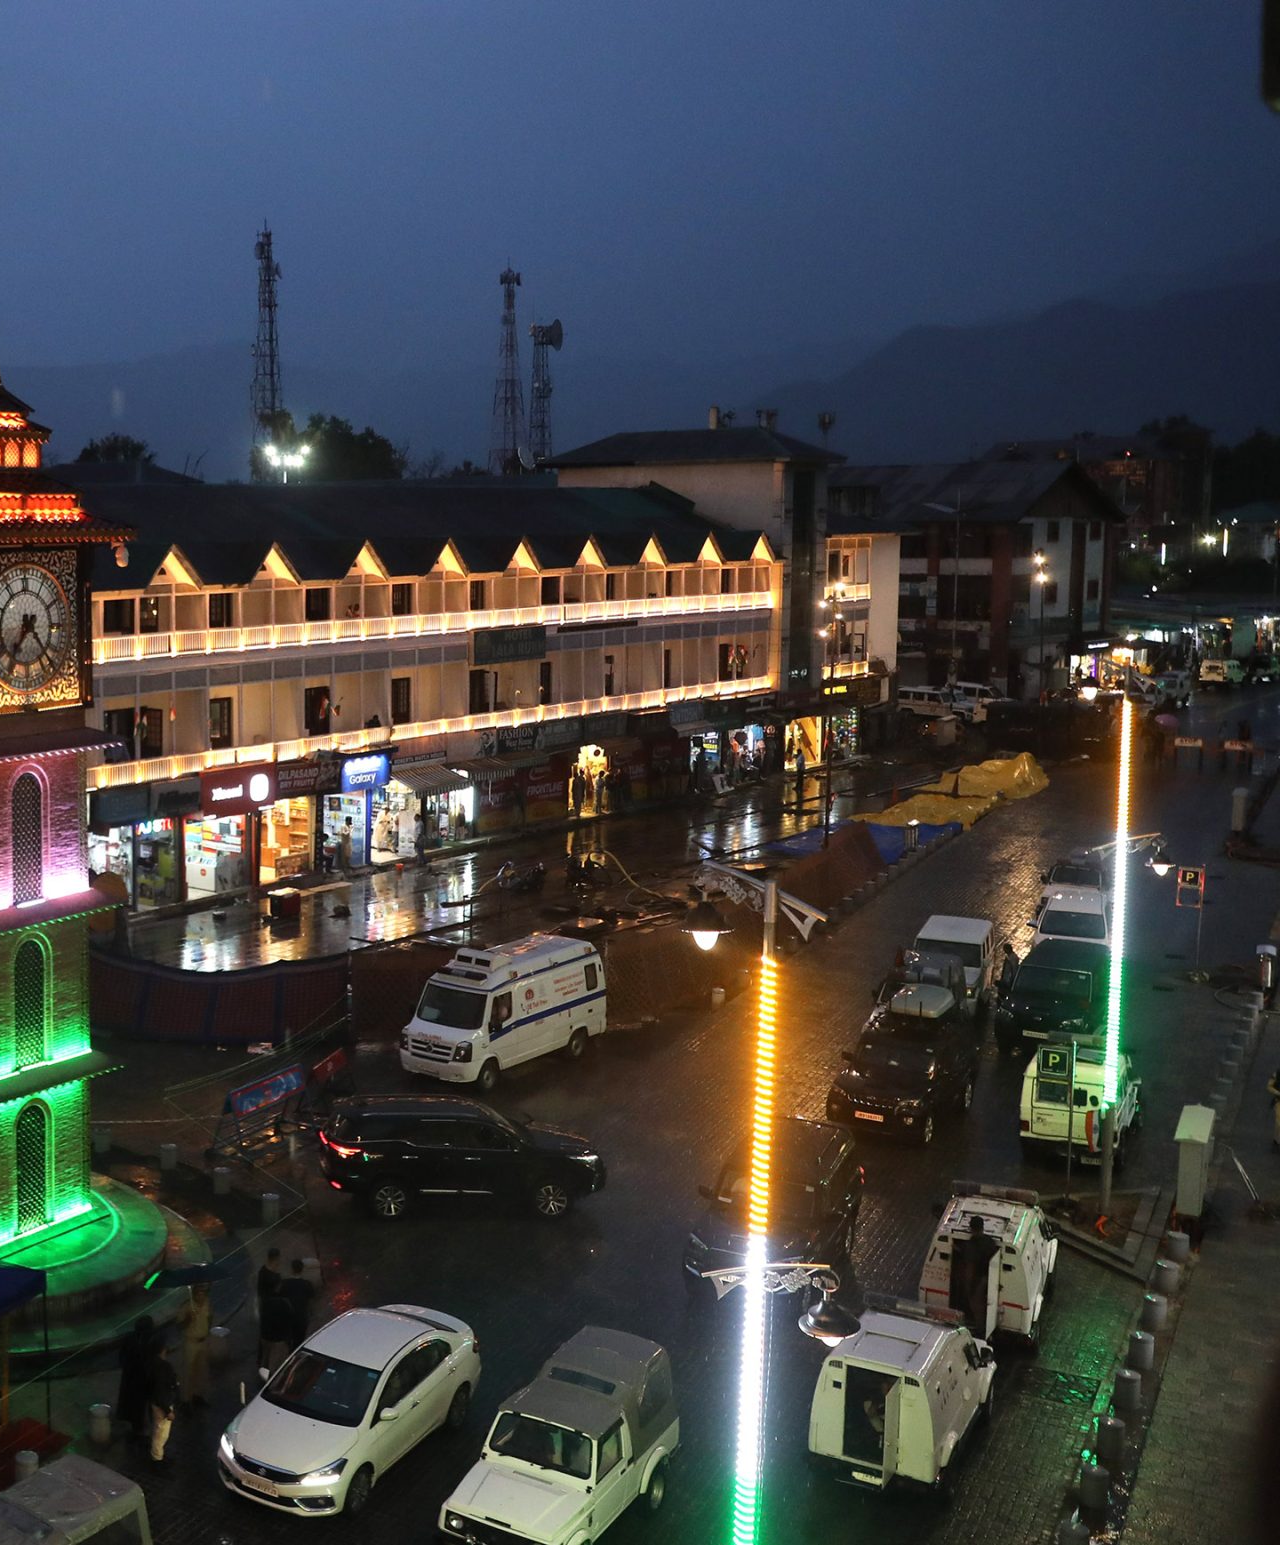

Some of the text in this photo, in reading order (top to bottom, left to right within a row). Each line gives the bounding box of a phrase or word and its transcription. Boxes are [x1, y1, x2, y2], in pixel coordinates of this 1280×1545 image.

[499, 727, 534, 740] FASHION
[278, 767, 319, 781] DILPASAND
[349, 773, 377, 785] Galaxy
[293, 778, 315, 788] FRUITS
[526, 781, 564, 796] FRONTLINE
[1186, 871, 1195, 882] P
[1048, 1053, 1060, 1067] P
